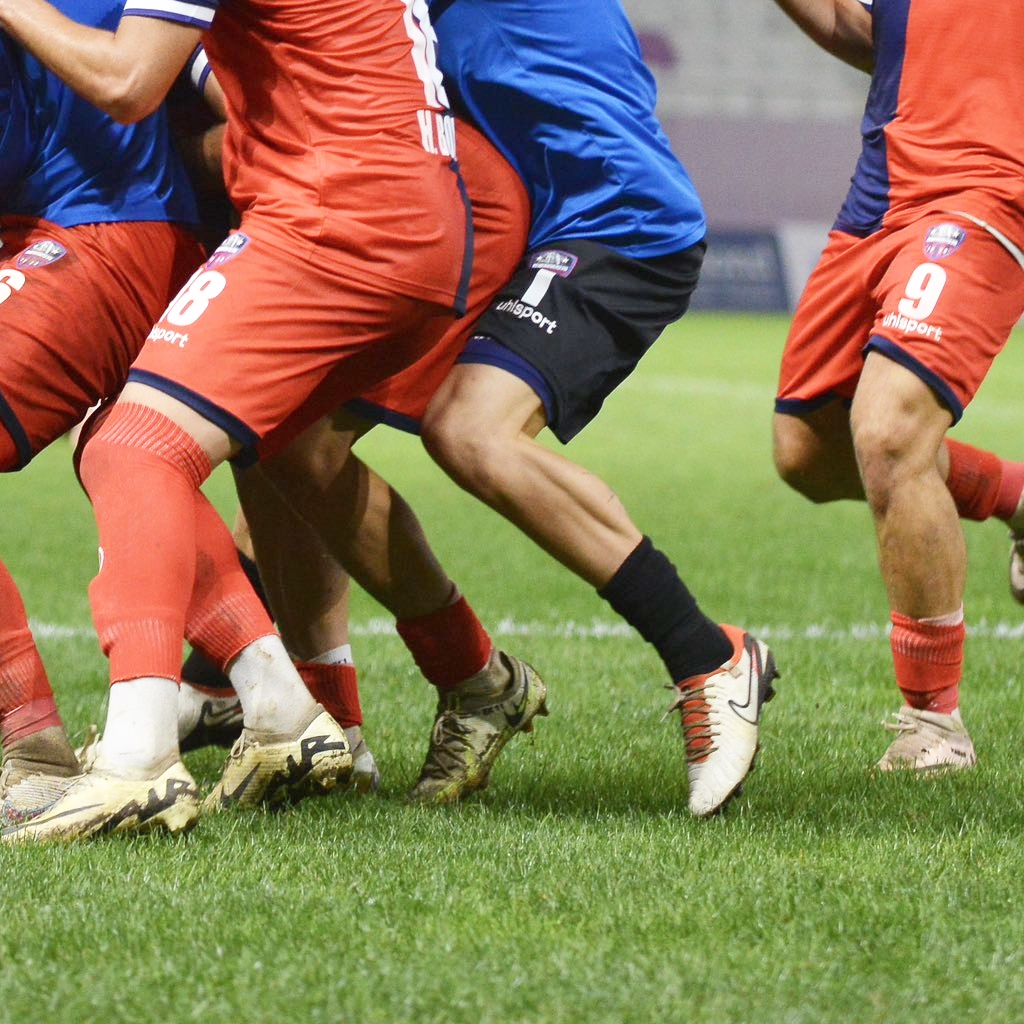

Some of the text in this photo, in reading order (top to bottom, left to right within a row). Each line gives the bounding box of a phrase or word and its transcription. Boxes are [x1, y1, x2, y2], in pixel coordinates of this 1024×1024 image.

[521, 268, 557, 308] 1
[898, 262, 947, 320] 9
[496, 299, 557, 334] uhlsport
[882, 312, 943, 342] uhlsport
